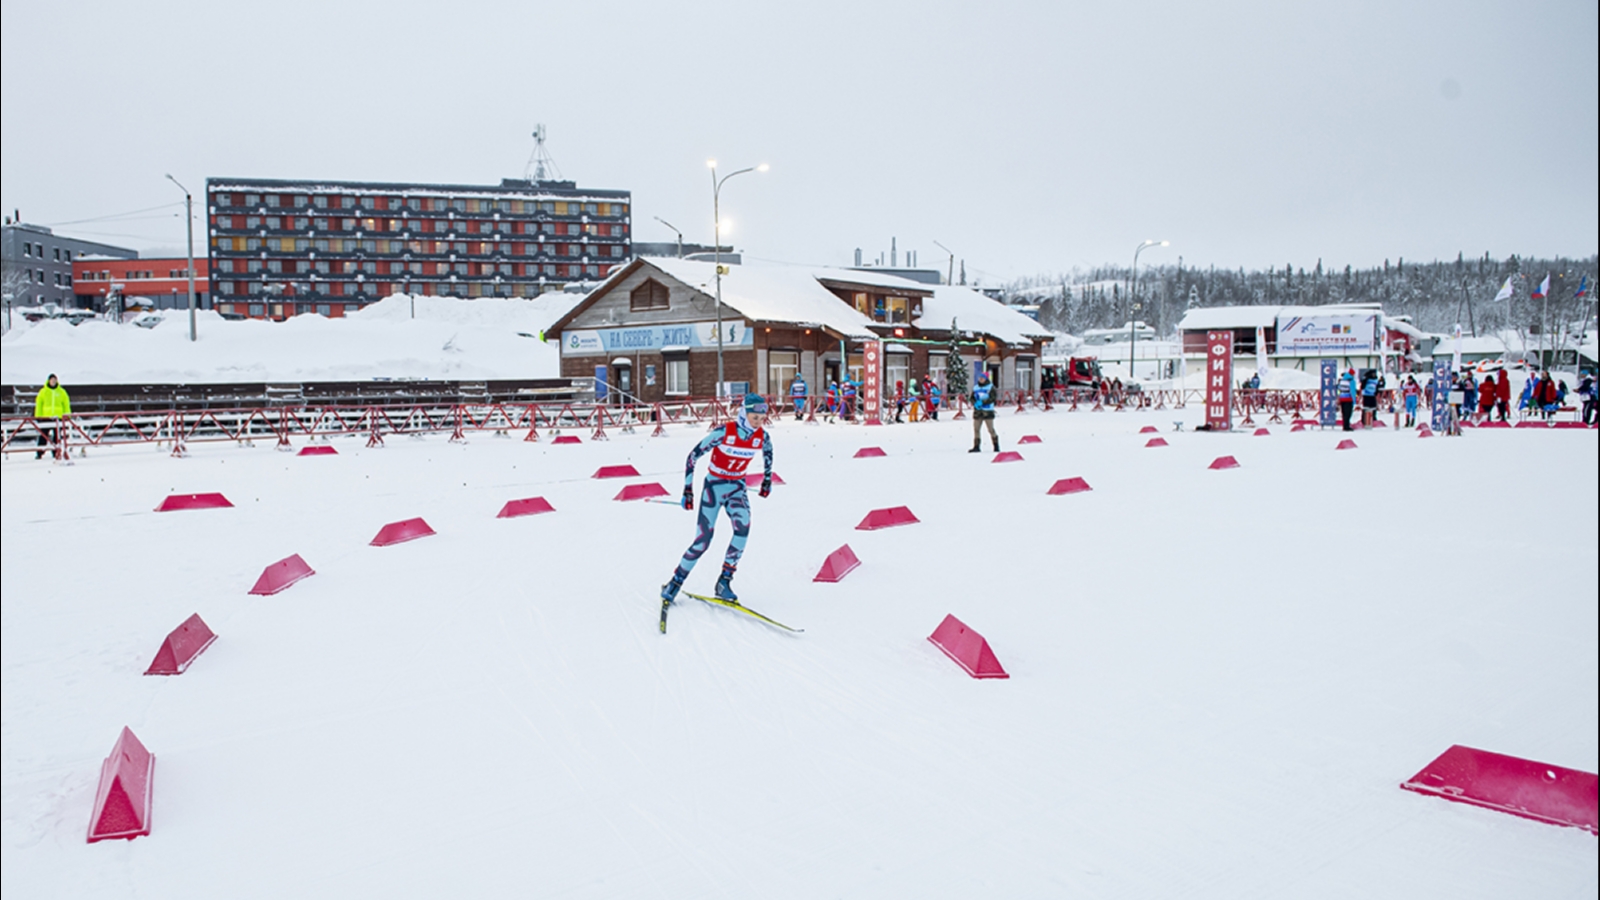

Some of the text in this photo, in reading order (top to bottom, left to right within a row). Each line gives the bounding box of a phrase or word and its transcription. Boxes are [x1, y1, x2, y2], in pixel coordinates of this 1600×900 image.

[610, 331, 621, 348] НА
[623, 329, 653, 347] СЕВЕРЕ
[662, 327, 692, 345] ЖИТЬ!
[866, 351, 877, 411] ФИНИШ
[1210, 344, 1226, 418] ФИНИШ
[1323, 366, 1331, 419] СТАРТ
[1434, 367, 1445, 423] СТАРТ
